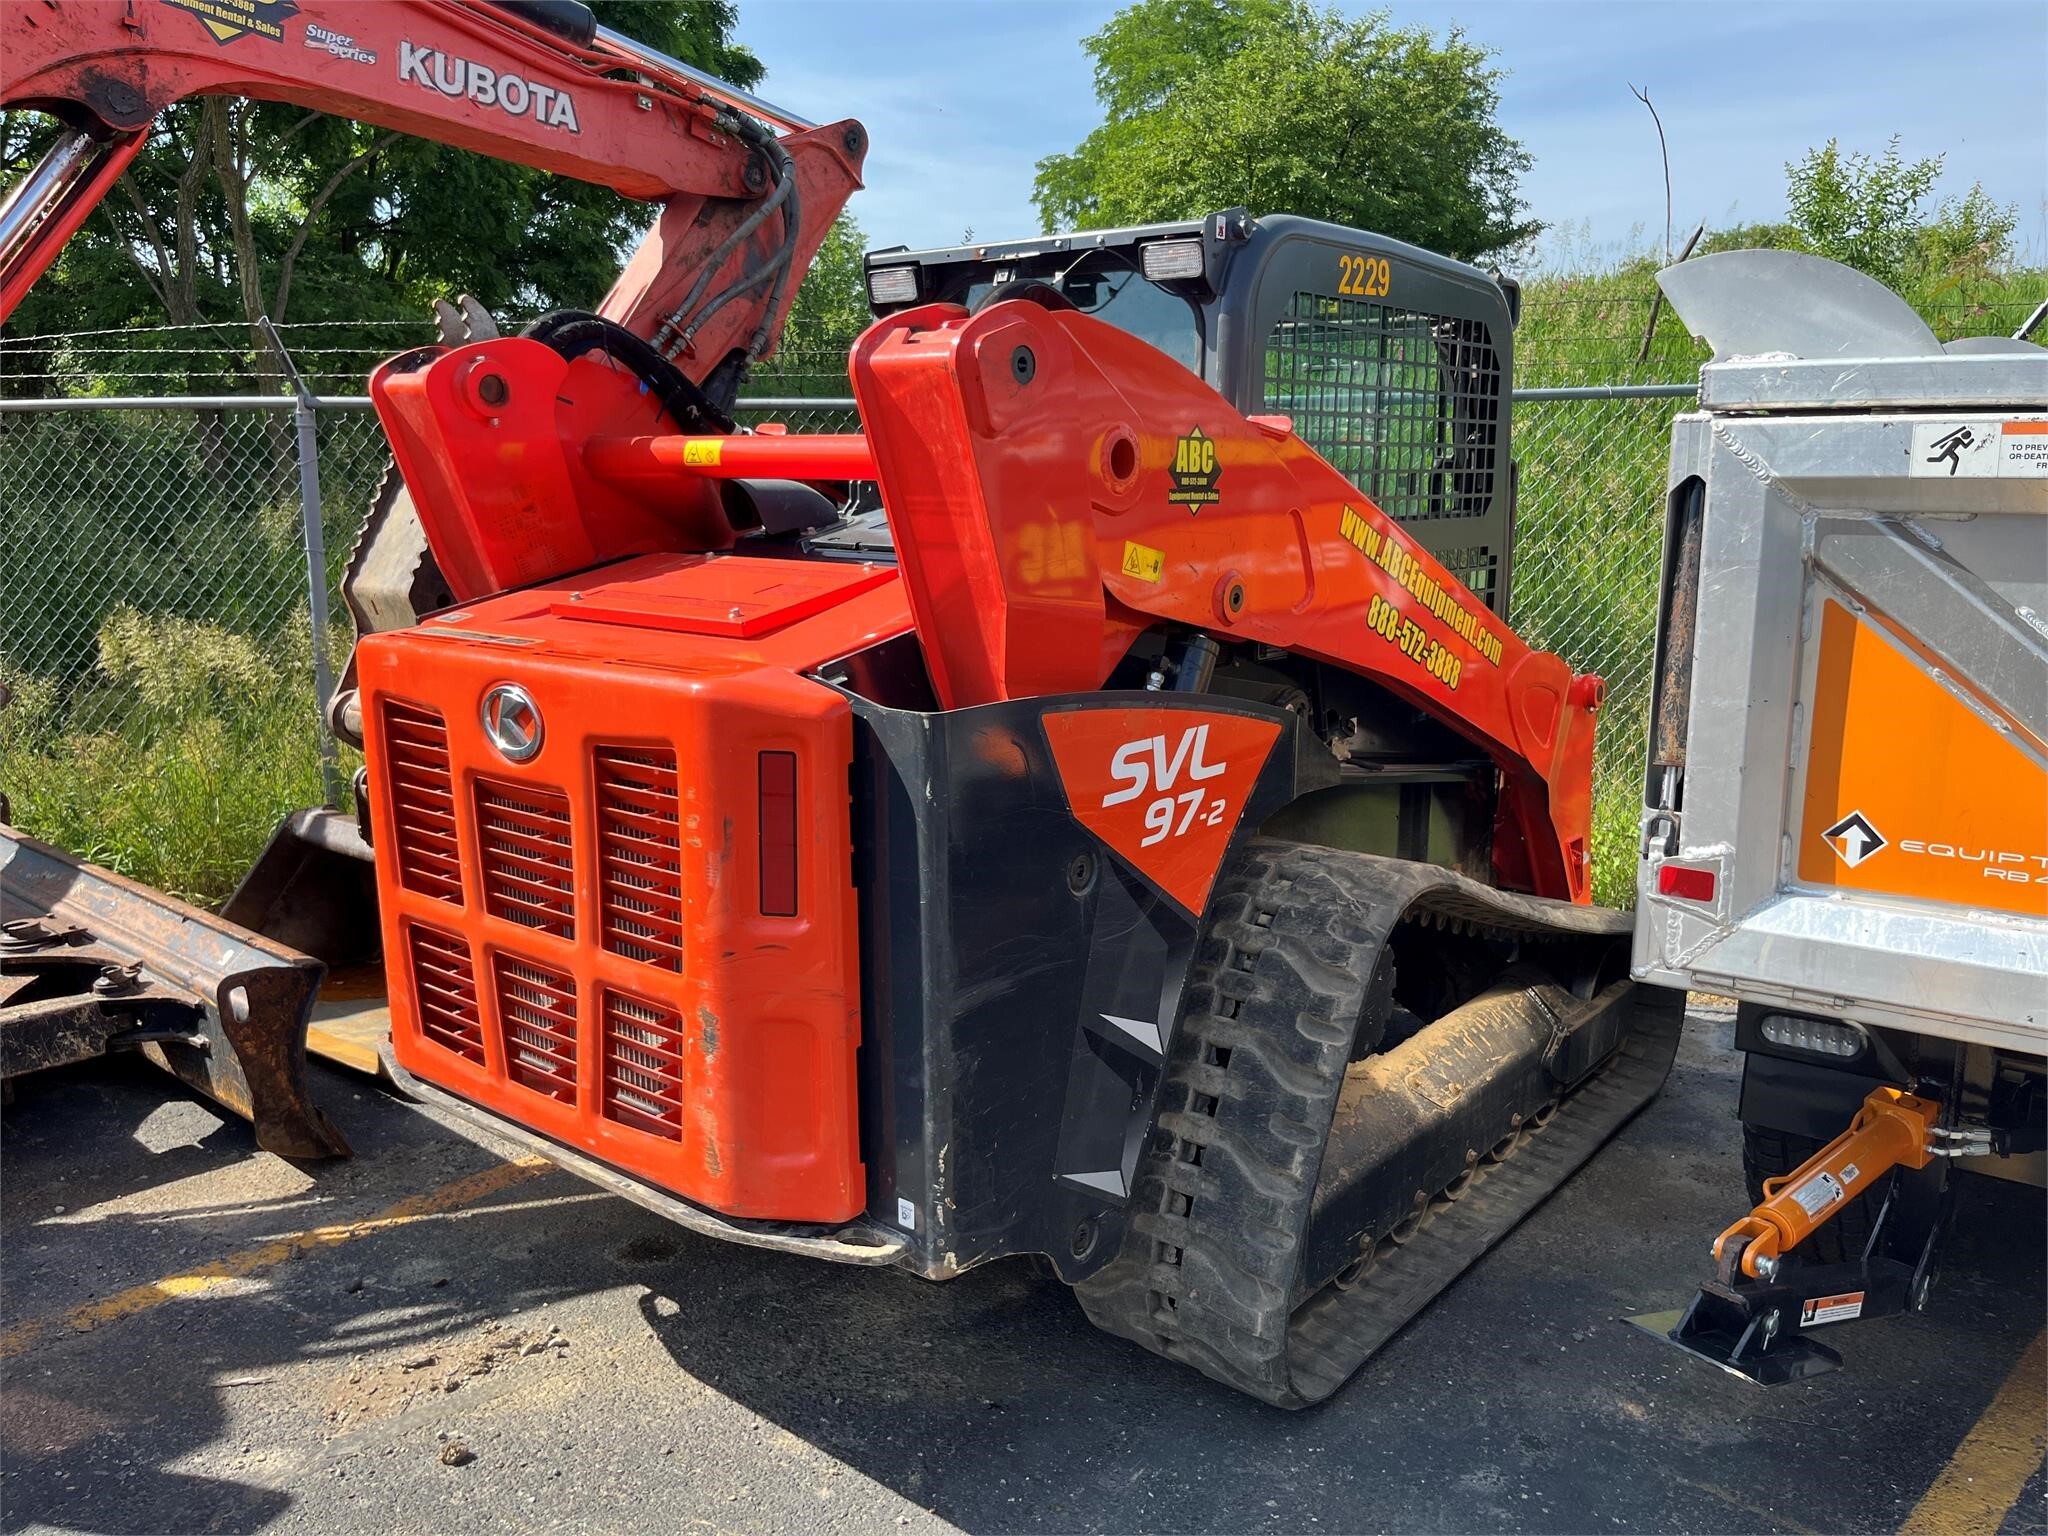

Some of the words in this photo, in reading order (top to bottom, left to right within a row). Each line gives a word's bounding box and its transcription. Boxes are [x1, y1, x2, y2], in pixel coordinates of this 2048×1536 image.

[215, 6, 247, 26] Rental
[247, 18, 254, 28] &
[255, 20, 281, 37] Sales
[306, 24, 353, 45] Super
[328, 42, 376, 65] Series
[399, 40, 580, 133] KUBOTA
[1338, 255, 1390, 297] 2229
[1176, 439, 1214, 474] ABC
[1339, 505, 1503, 667] www.ABCEquipment.com
[1367, 594, 1462, 689] 888-572-3888
[1102, 724, 1227, 808] SVL
[1141, 788, 1226, 848] 97-2
